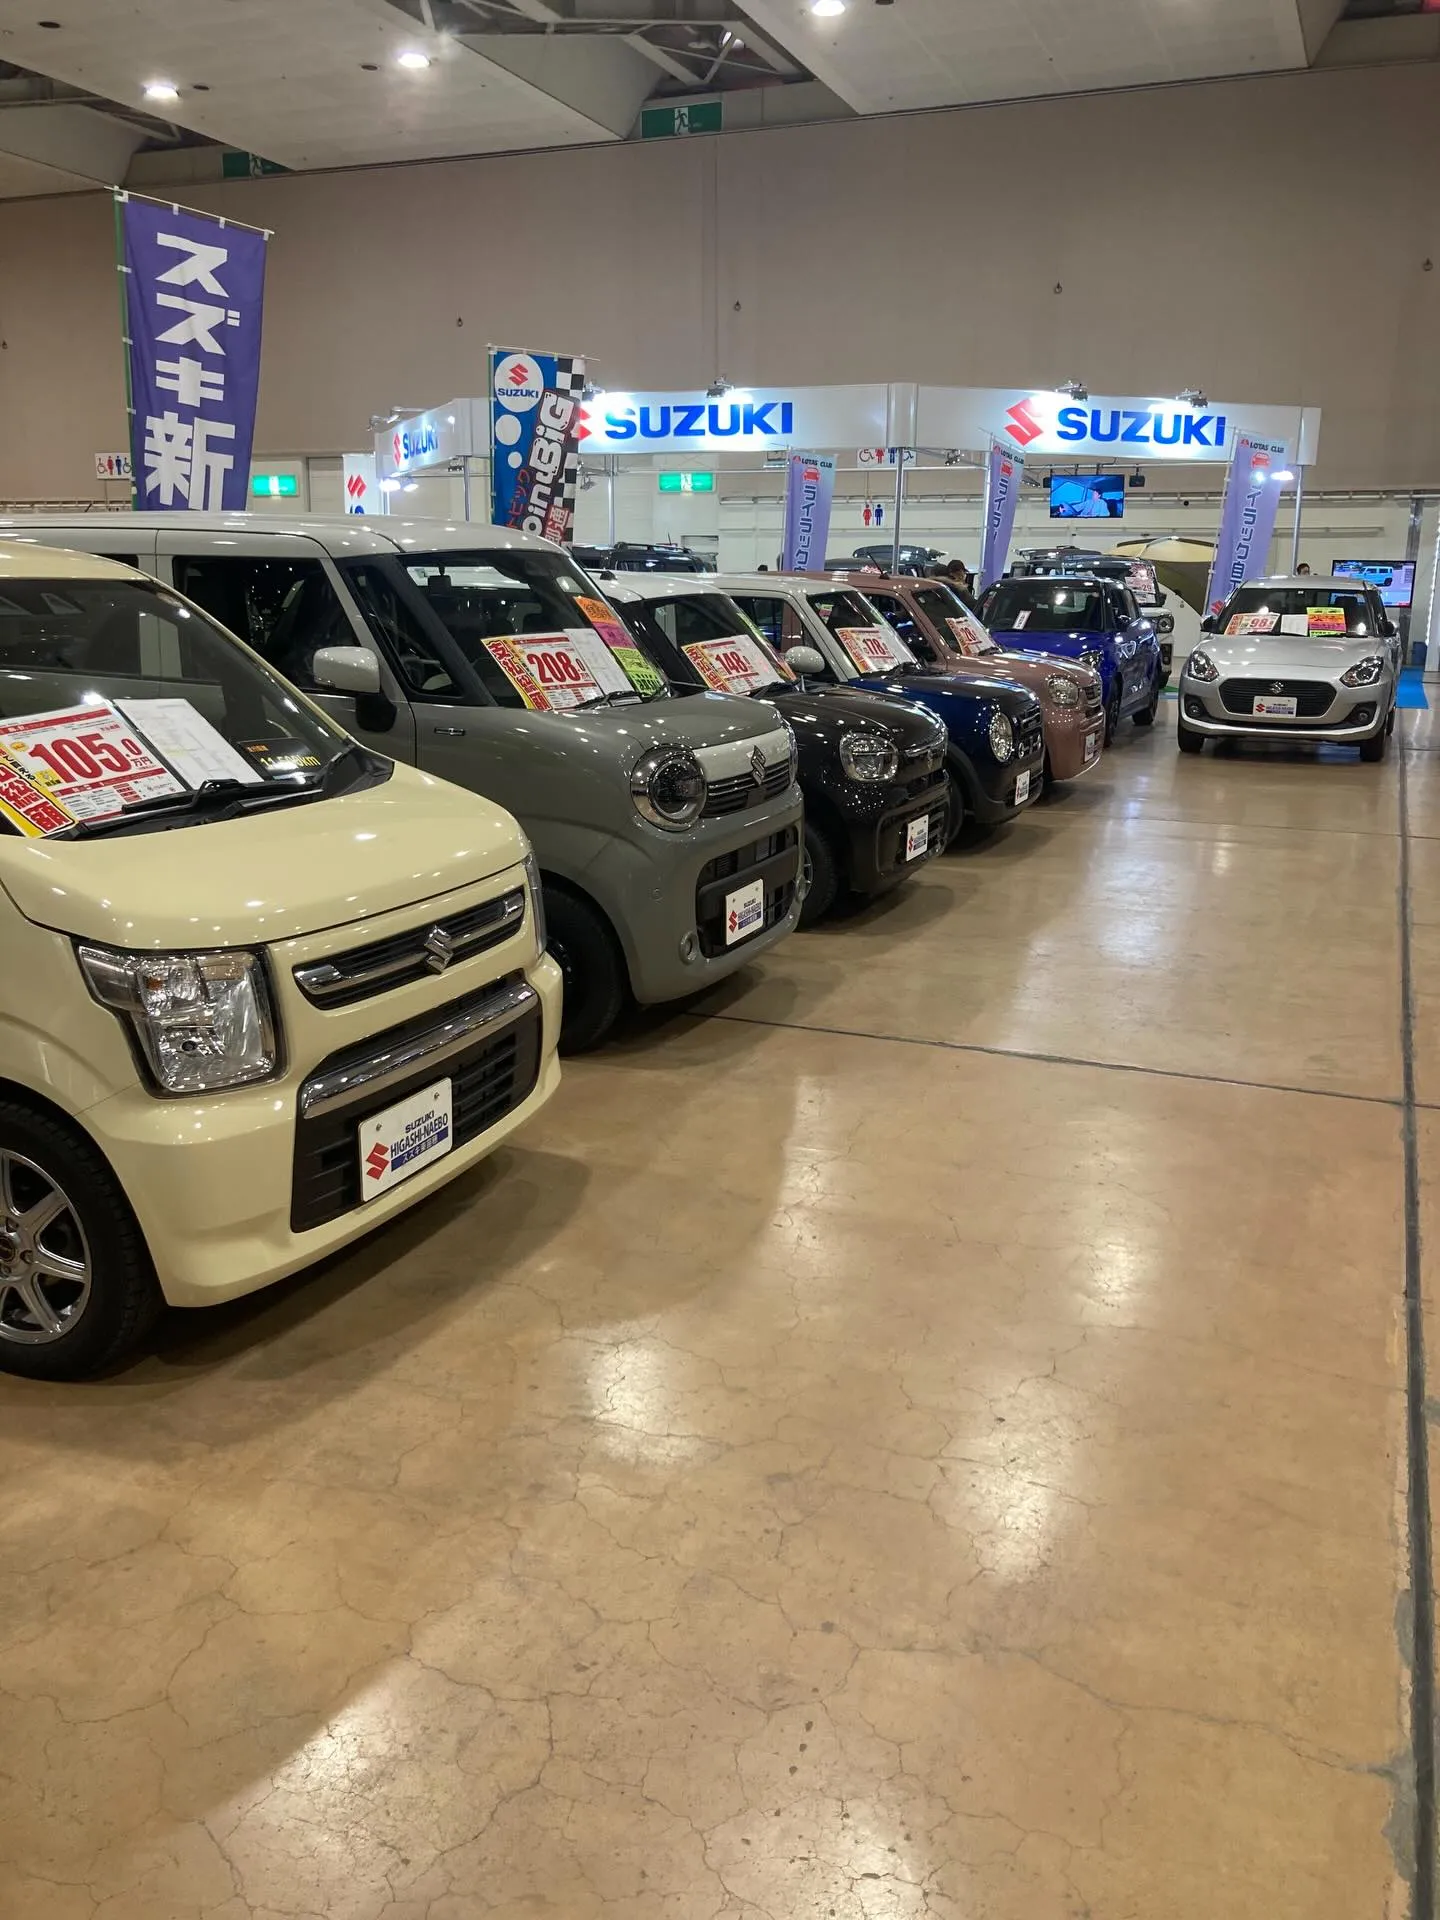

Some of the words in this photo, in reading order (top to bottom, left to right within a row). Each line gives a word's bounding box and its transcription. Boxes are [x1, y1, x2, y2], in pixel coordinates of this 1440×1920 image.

[498, 388, 539, 399] SUZUKI
[605, 402, 793, 440] SUZUKI
[1057, 407, 1227, 446] SUZUKI
[403, 428, 438, 460] SUZUKI
[526, 651, 586, 684] 208.0
[28, 733, 143, 784] 105.0
[390, 1112, 448, 1158] HIGASHI-NAEBO
[405, 1110, 435, 1133] SUZUKI
